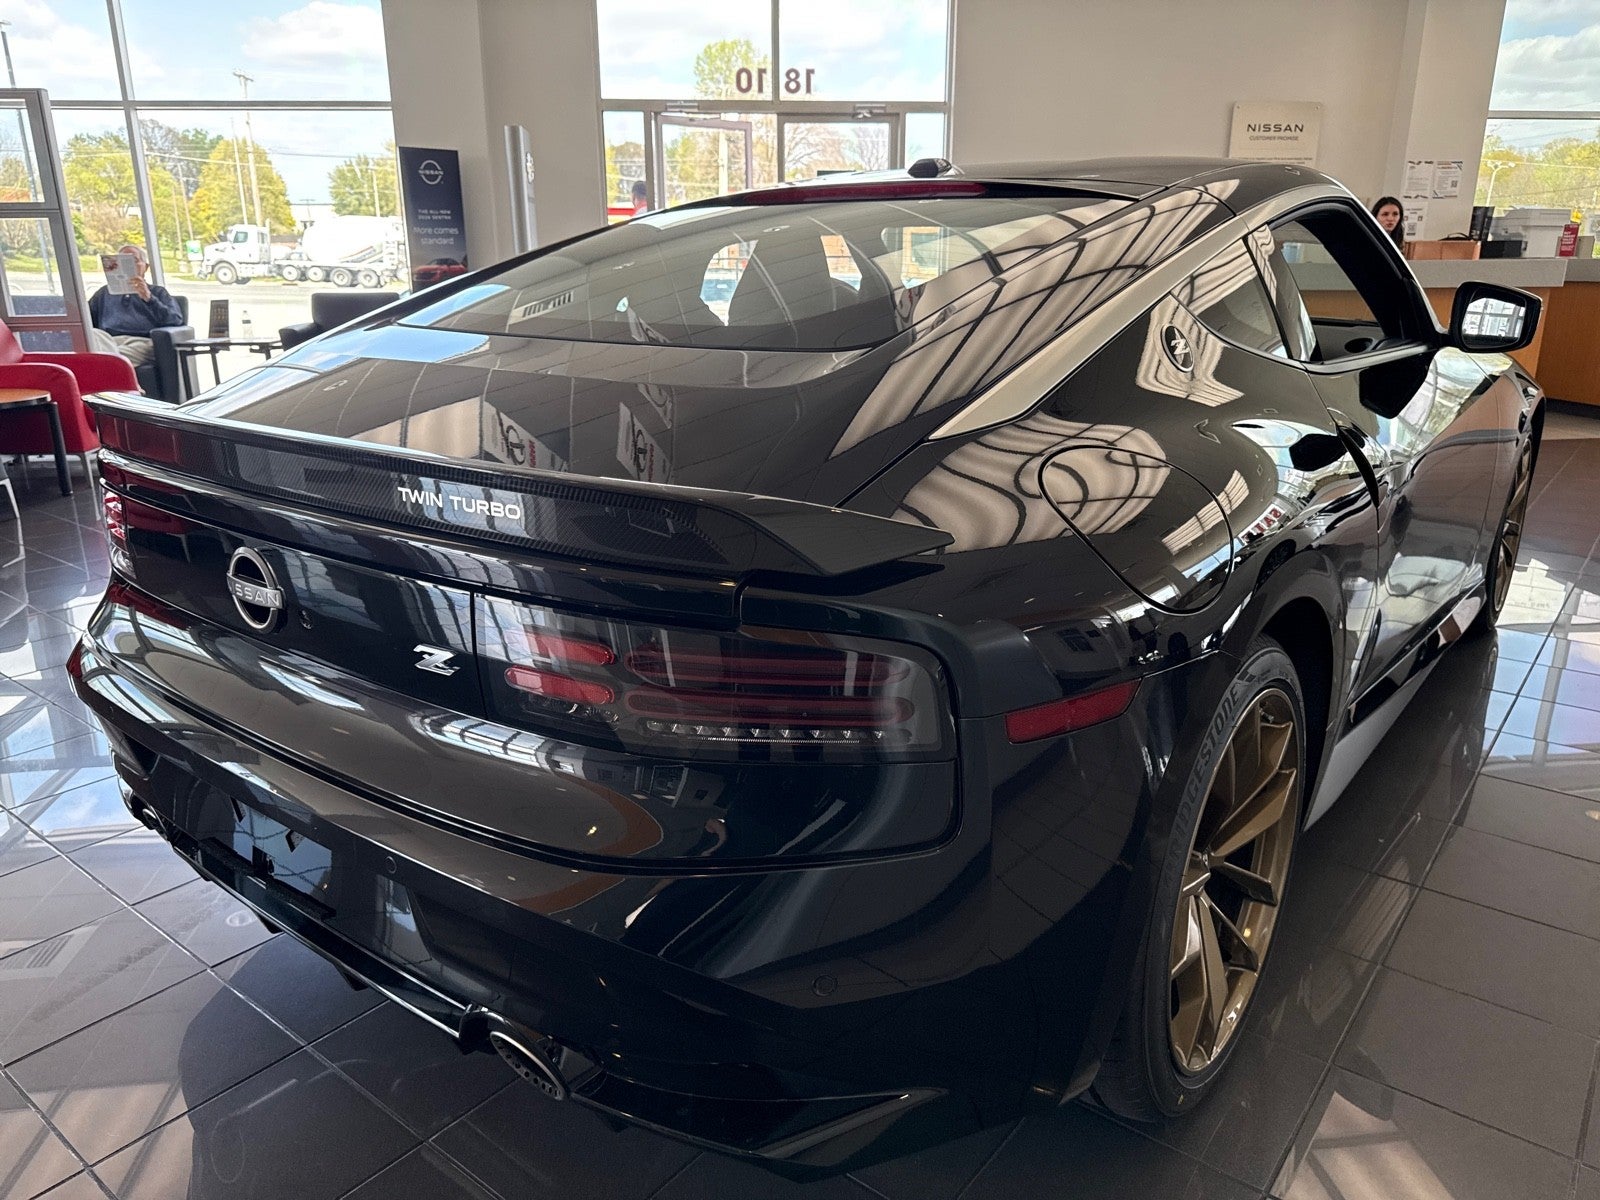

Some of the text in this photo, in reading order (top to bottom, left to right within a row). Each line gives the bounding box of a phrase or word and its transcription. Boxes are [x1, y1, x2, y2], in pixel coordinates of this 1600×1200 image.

[1246, 124, 1304, 133] NISSAN
[434, 227, 459, 235] comes
[421, 237, 454, 245] standard
[397, 486, 521, 520] TWIN TURBO
[413, 644, 461, 676] Z
